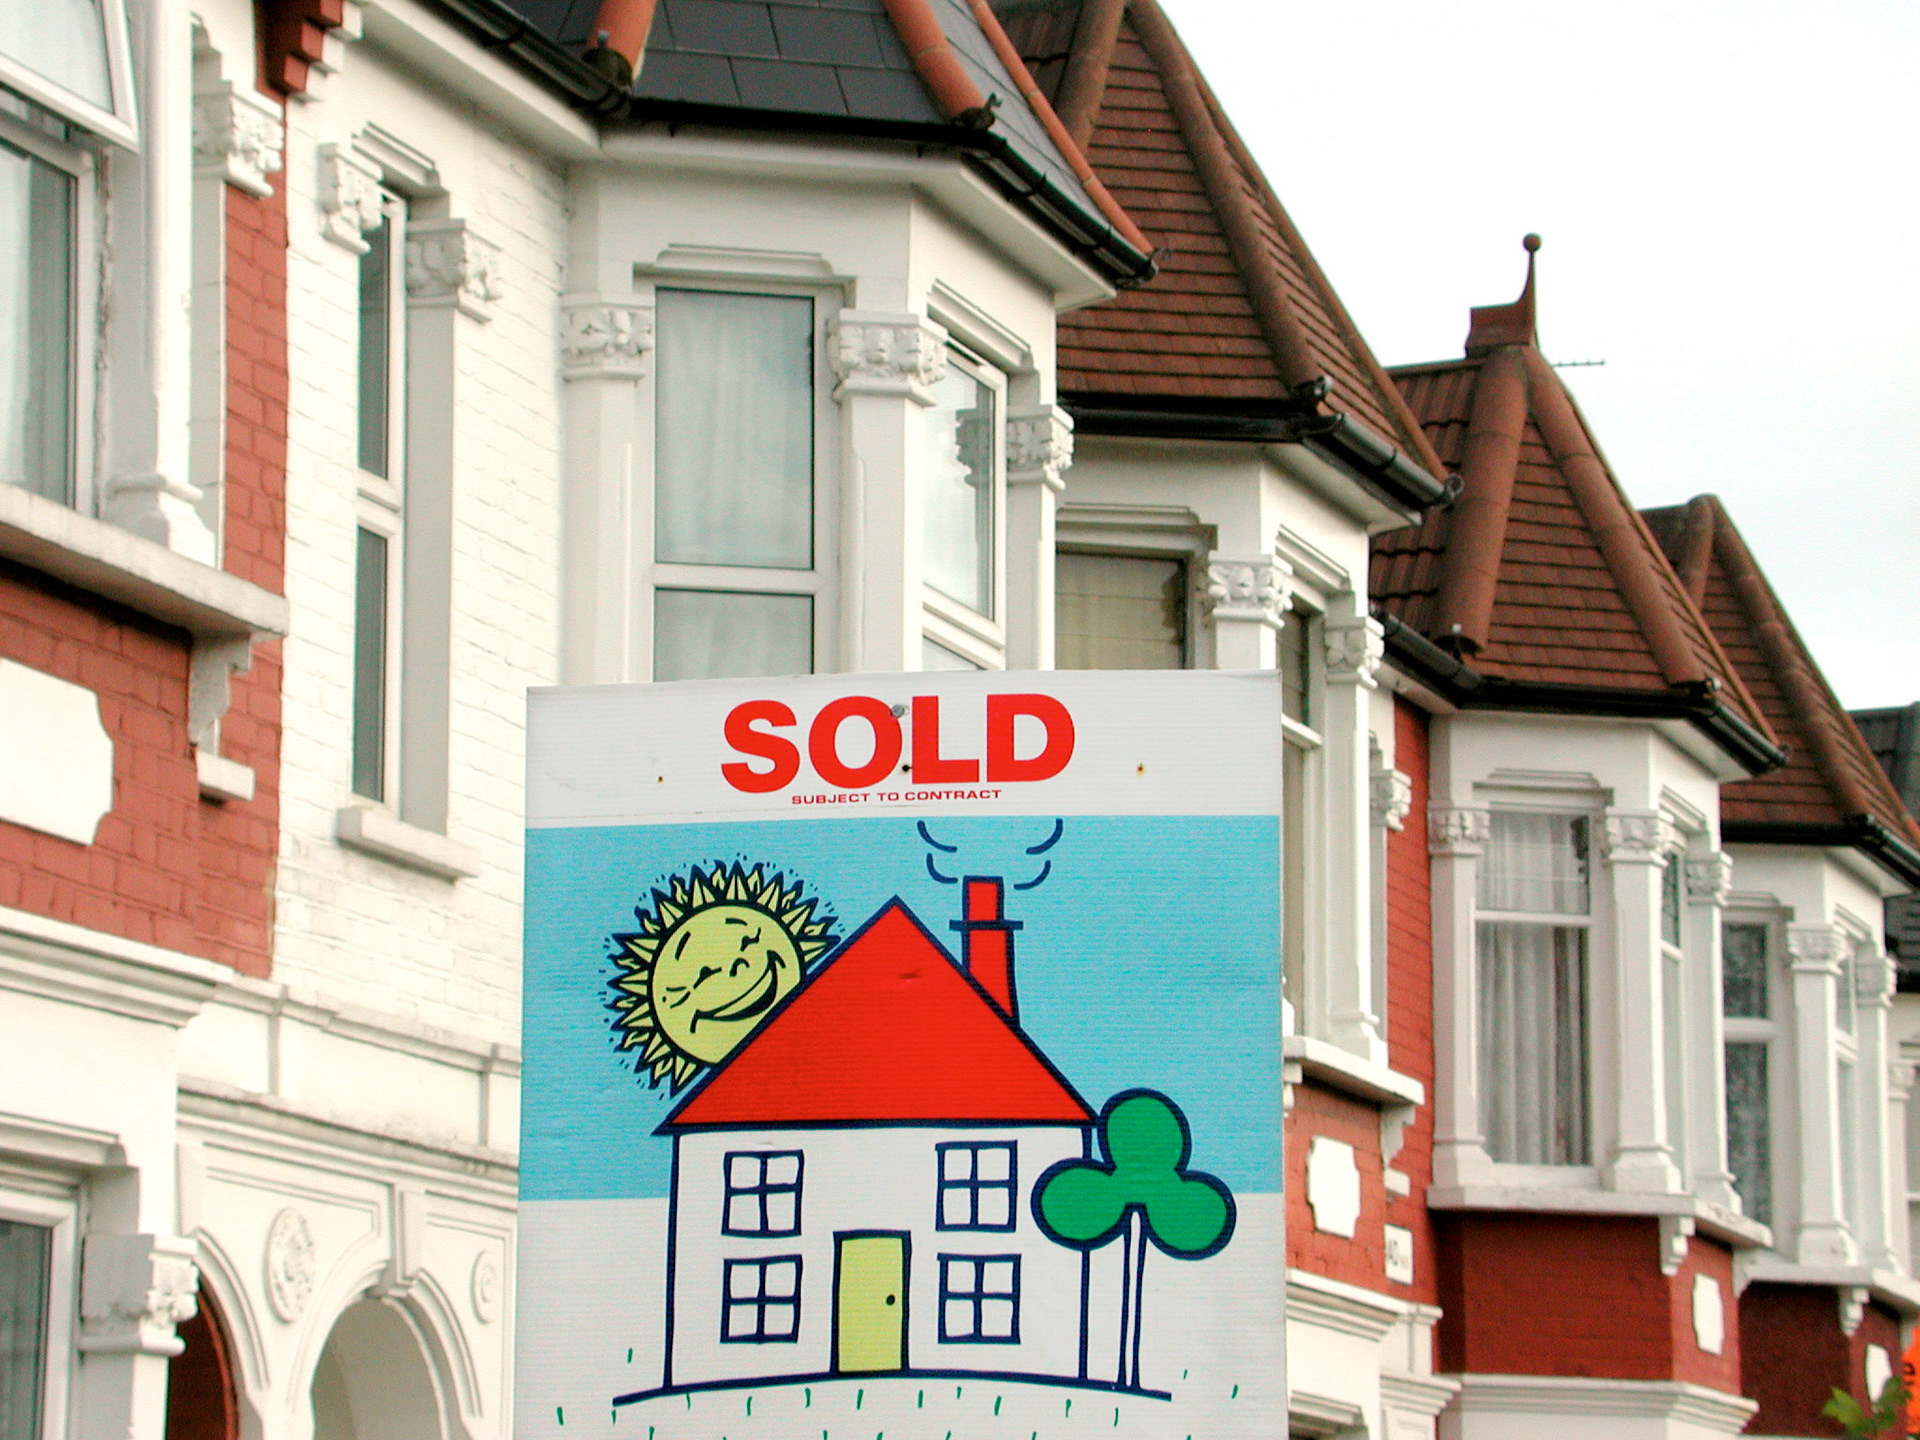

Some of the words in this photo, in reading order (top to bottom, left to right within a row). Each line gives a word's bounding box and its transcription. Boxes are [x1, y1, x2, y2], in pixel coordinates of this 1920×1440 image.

[721, 693, 1075, 793] SOLD
[791, 793, 870, 805] SUBJECT
[877, 792, 899, 802] TO
[904, 789, 1002, 801] CONTRACT
